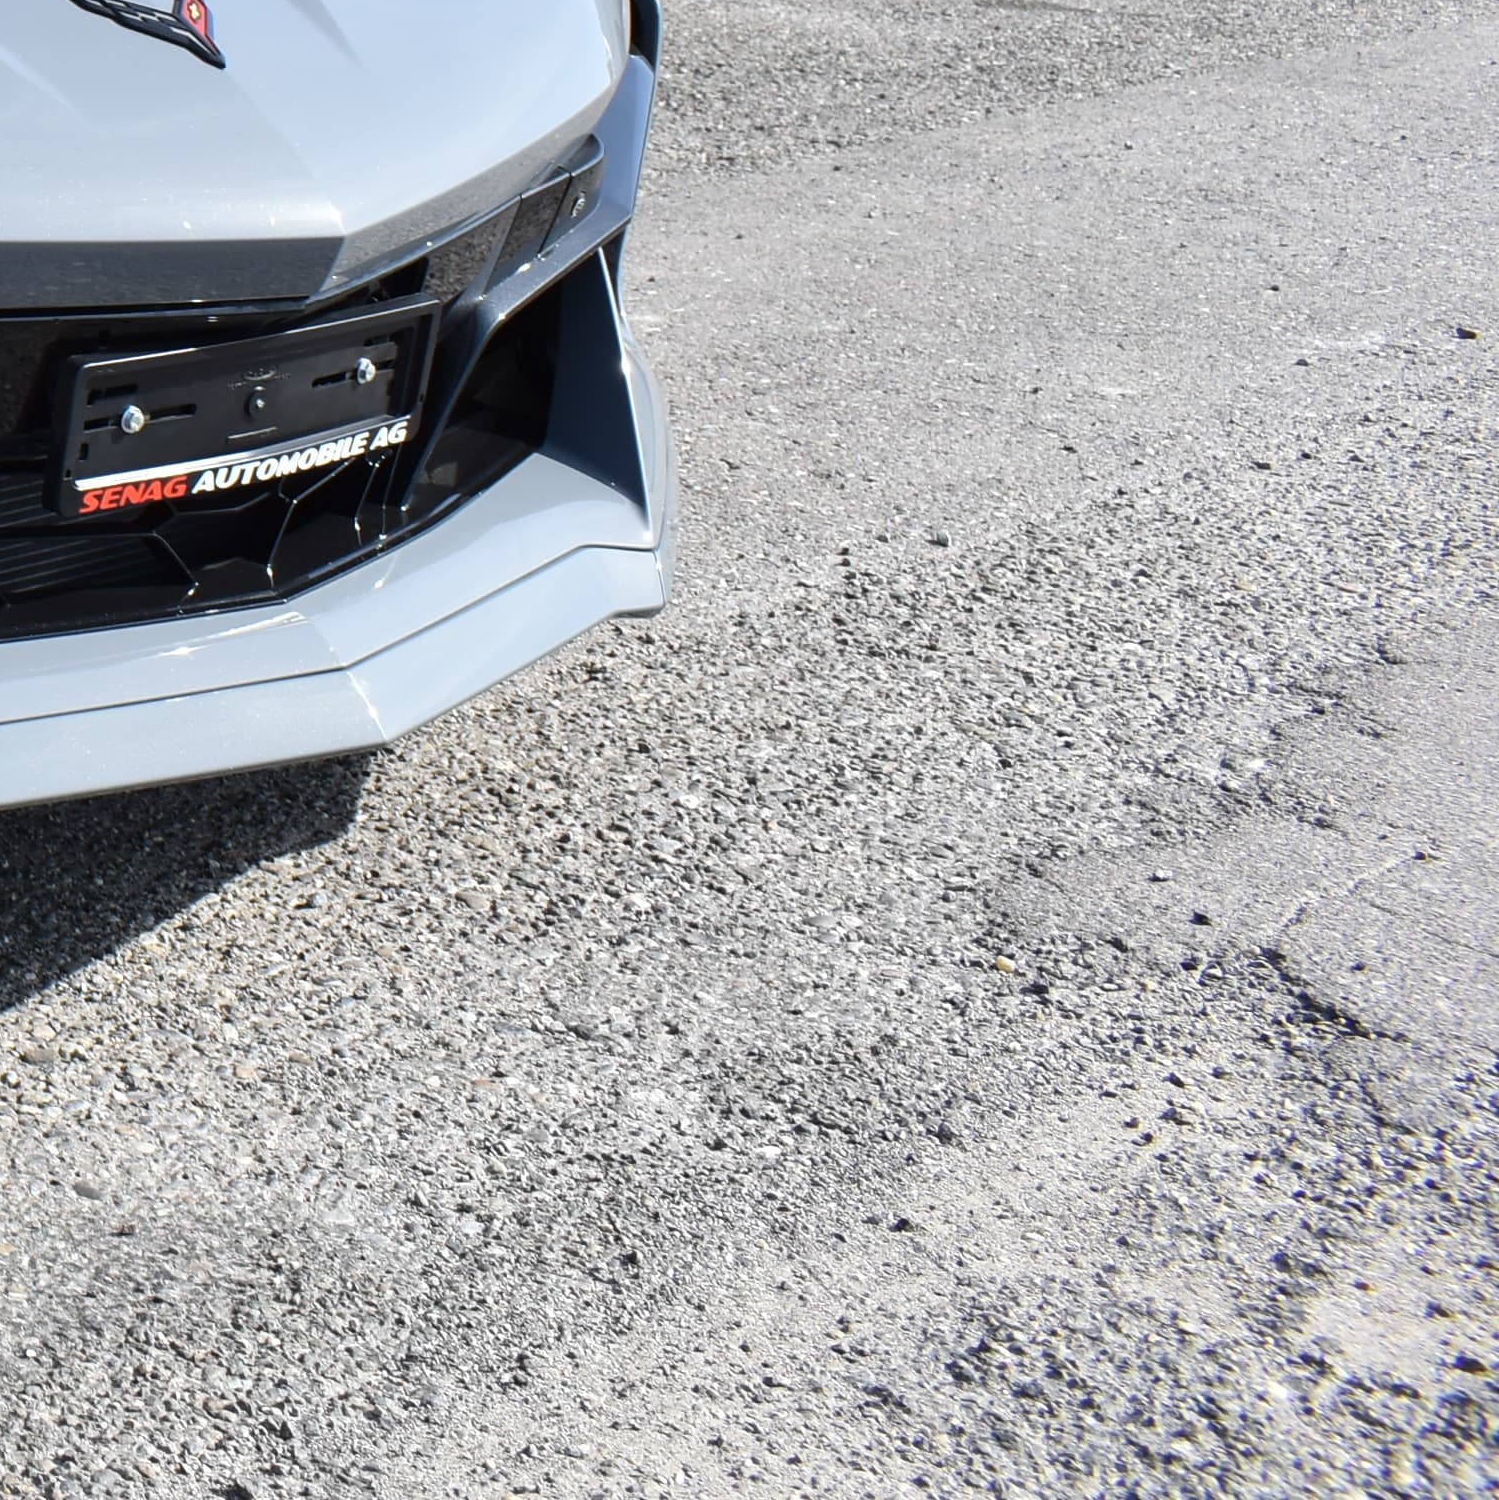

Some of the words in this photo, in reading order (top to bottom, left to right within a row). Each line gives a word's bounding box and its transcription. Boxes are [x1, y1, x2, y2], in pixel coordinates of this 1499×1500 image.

[78, 476, 188, 514] SENAG
[190, 433, 370, 495] AUTOMOBILE
[369, 421, 409, 450] AG
